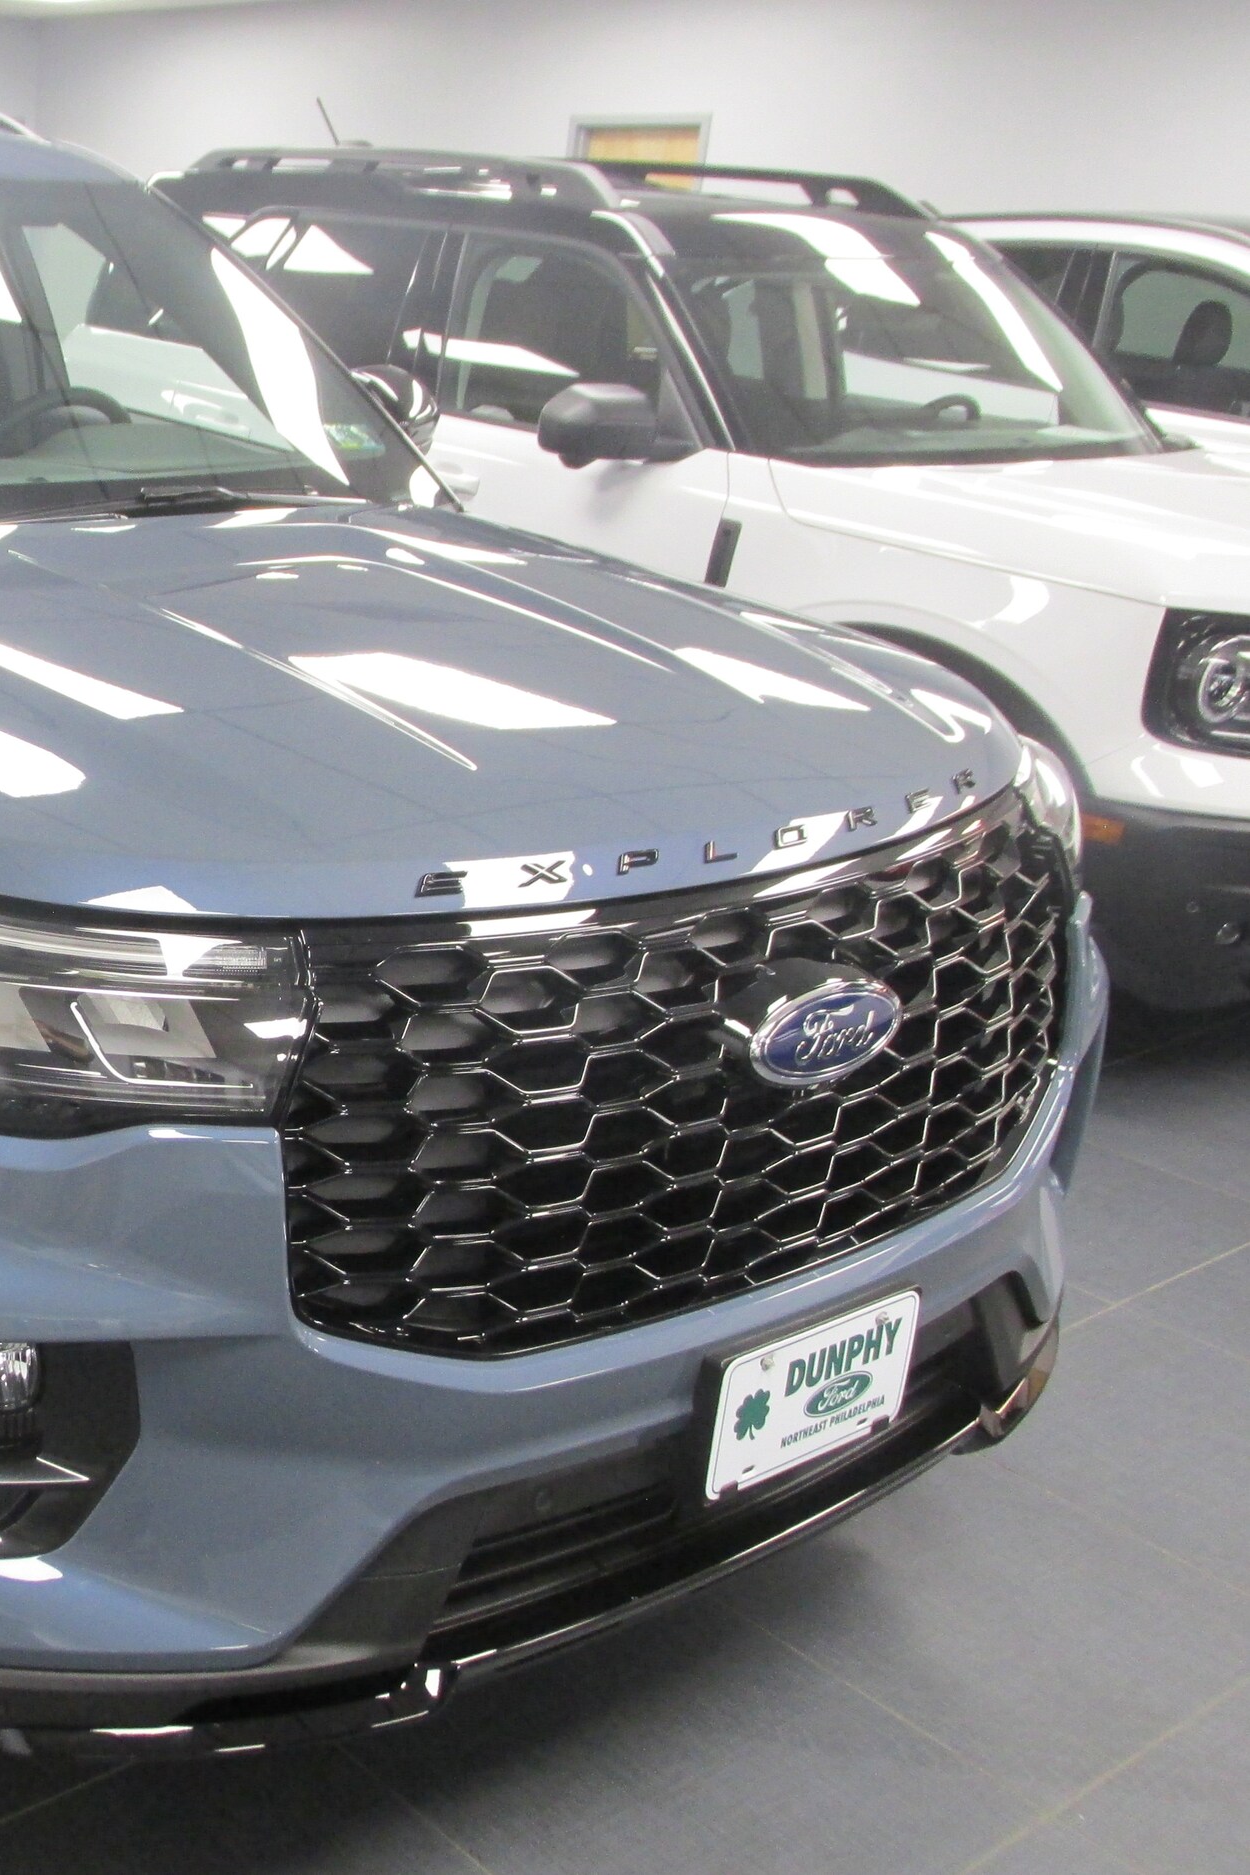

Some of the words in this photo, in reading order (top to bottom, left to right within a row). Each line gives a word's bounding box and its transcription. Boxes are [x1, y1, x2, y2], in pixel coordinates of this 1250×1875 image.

[414, 768, 977, 897] EXPLORER
[794, 1004, 875, 1066] Ford
[785, 1317, 902, 1396] DUNPHY
[781, 1420, 827, 1447] NORTHEAST
[830, 1396, 885, 1426] PHILADELPHIA
[818, 1379, 858, 1411] Ford
